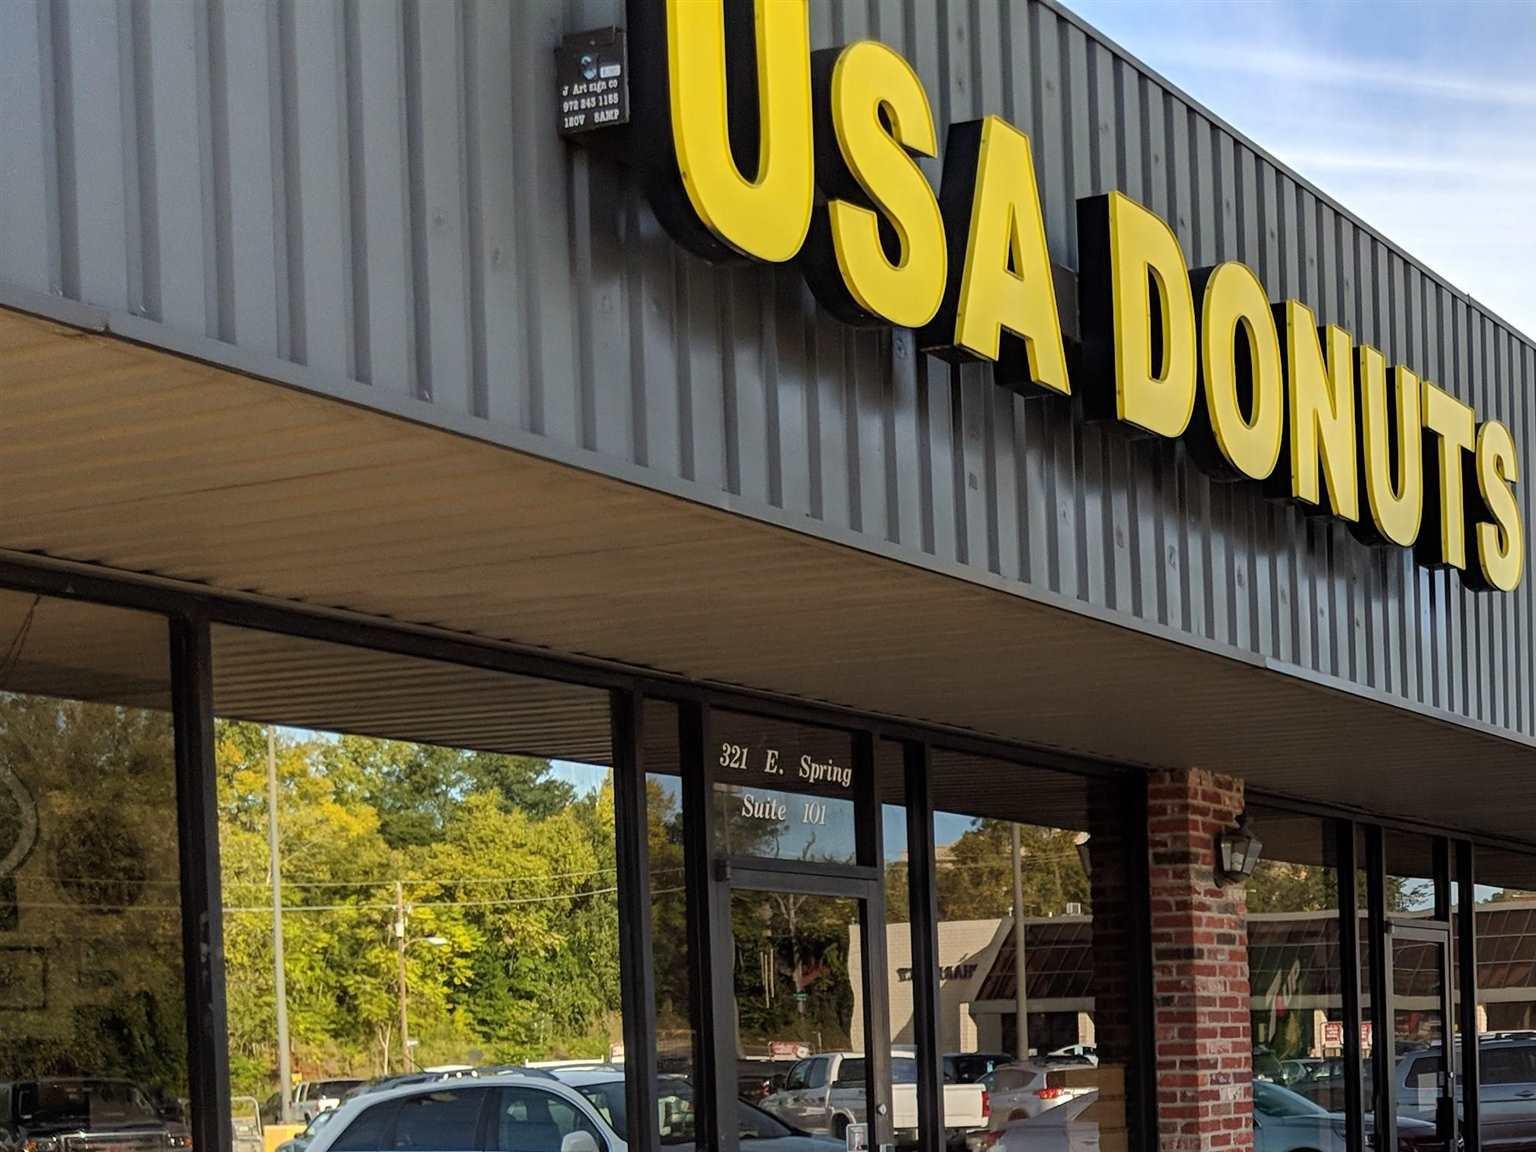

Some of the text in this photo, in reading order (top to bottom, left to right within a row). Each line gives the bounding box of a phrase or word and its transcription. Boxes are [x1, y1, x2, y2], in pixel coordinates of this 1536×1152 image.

[572, 83, 587, 95] Art
[589, 81, 607, 93] sign
[662, 0, 1071, 397] USA
[1105, 190, 1525, 593] DONUTS
[719, 742, 852, 787] 321 E. Spring
[741, 793, 826, 825] Suite 101
